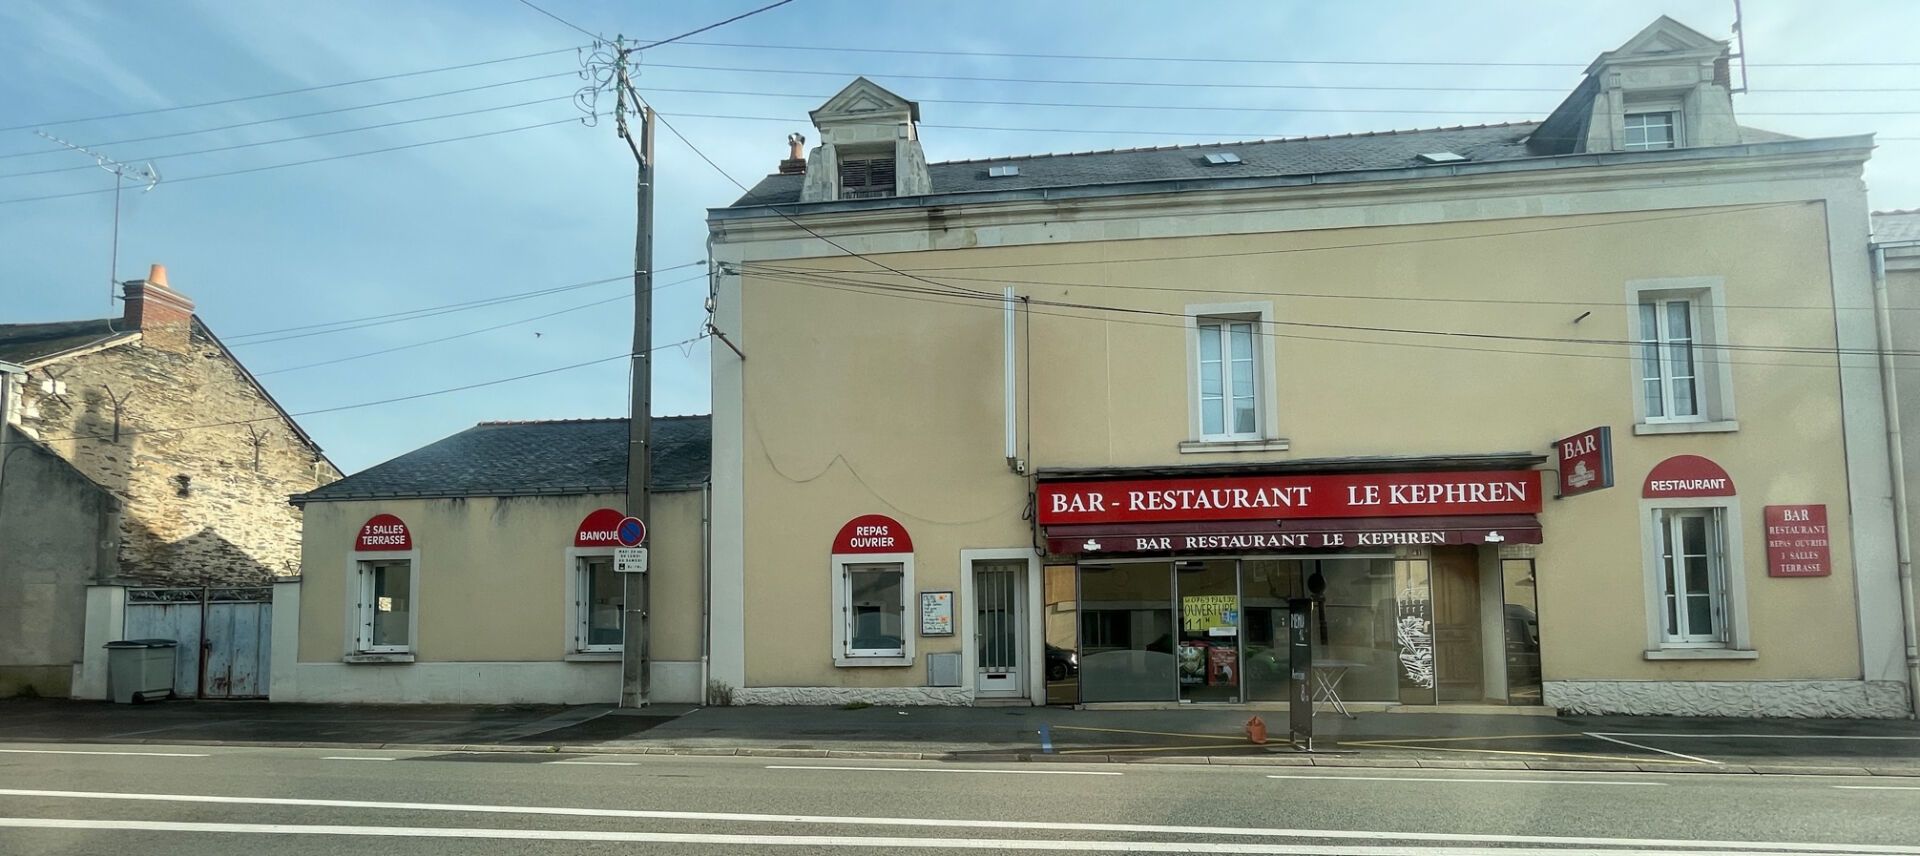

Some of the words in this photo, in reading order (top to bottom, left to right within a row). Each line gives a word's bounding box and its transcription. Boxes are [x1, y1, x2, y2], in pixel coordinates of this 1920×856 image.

[1564, 435, 1597, 460] BAR
[1651, 479, 1726, 491] RESTAURANT
[1051, 493, 1105, 513] BAR
[1128, 486, 1312, 511] RESTAURANT
[1347, 485, 1381, 506] LE
[1389, 481, 1527, 505] KEPHREN
[1784, 509, 1810, 521] BAR
[365, 526, 370, 535] 3
[373, 525, 404, 534] SALLES
[857, 526, 888, 536] REPAS
[1769, 525, 1826, 535] RESTAURANT
[362, 536, 405, 545] TERRASSE
[850, 537, 894, 548] OUVRIER
[1136, 537, 1172, 550] BAR
[1185, 534, 1309, 549] RESTAURANT
[1322, 534, 1344, 546] LE
[1358, 532, 1446, 546] KEPHREN
[1795, 539, 1828, 547] OUVRIER
[1790, 552, 1819, 560] SALLES
[1780, 563, 1821, 572] TERRASSE
